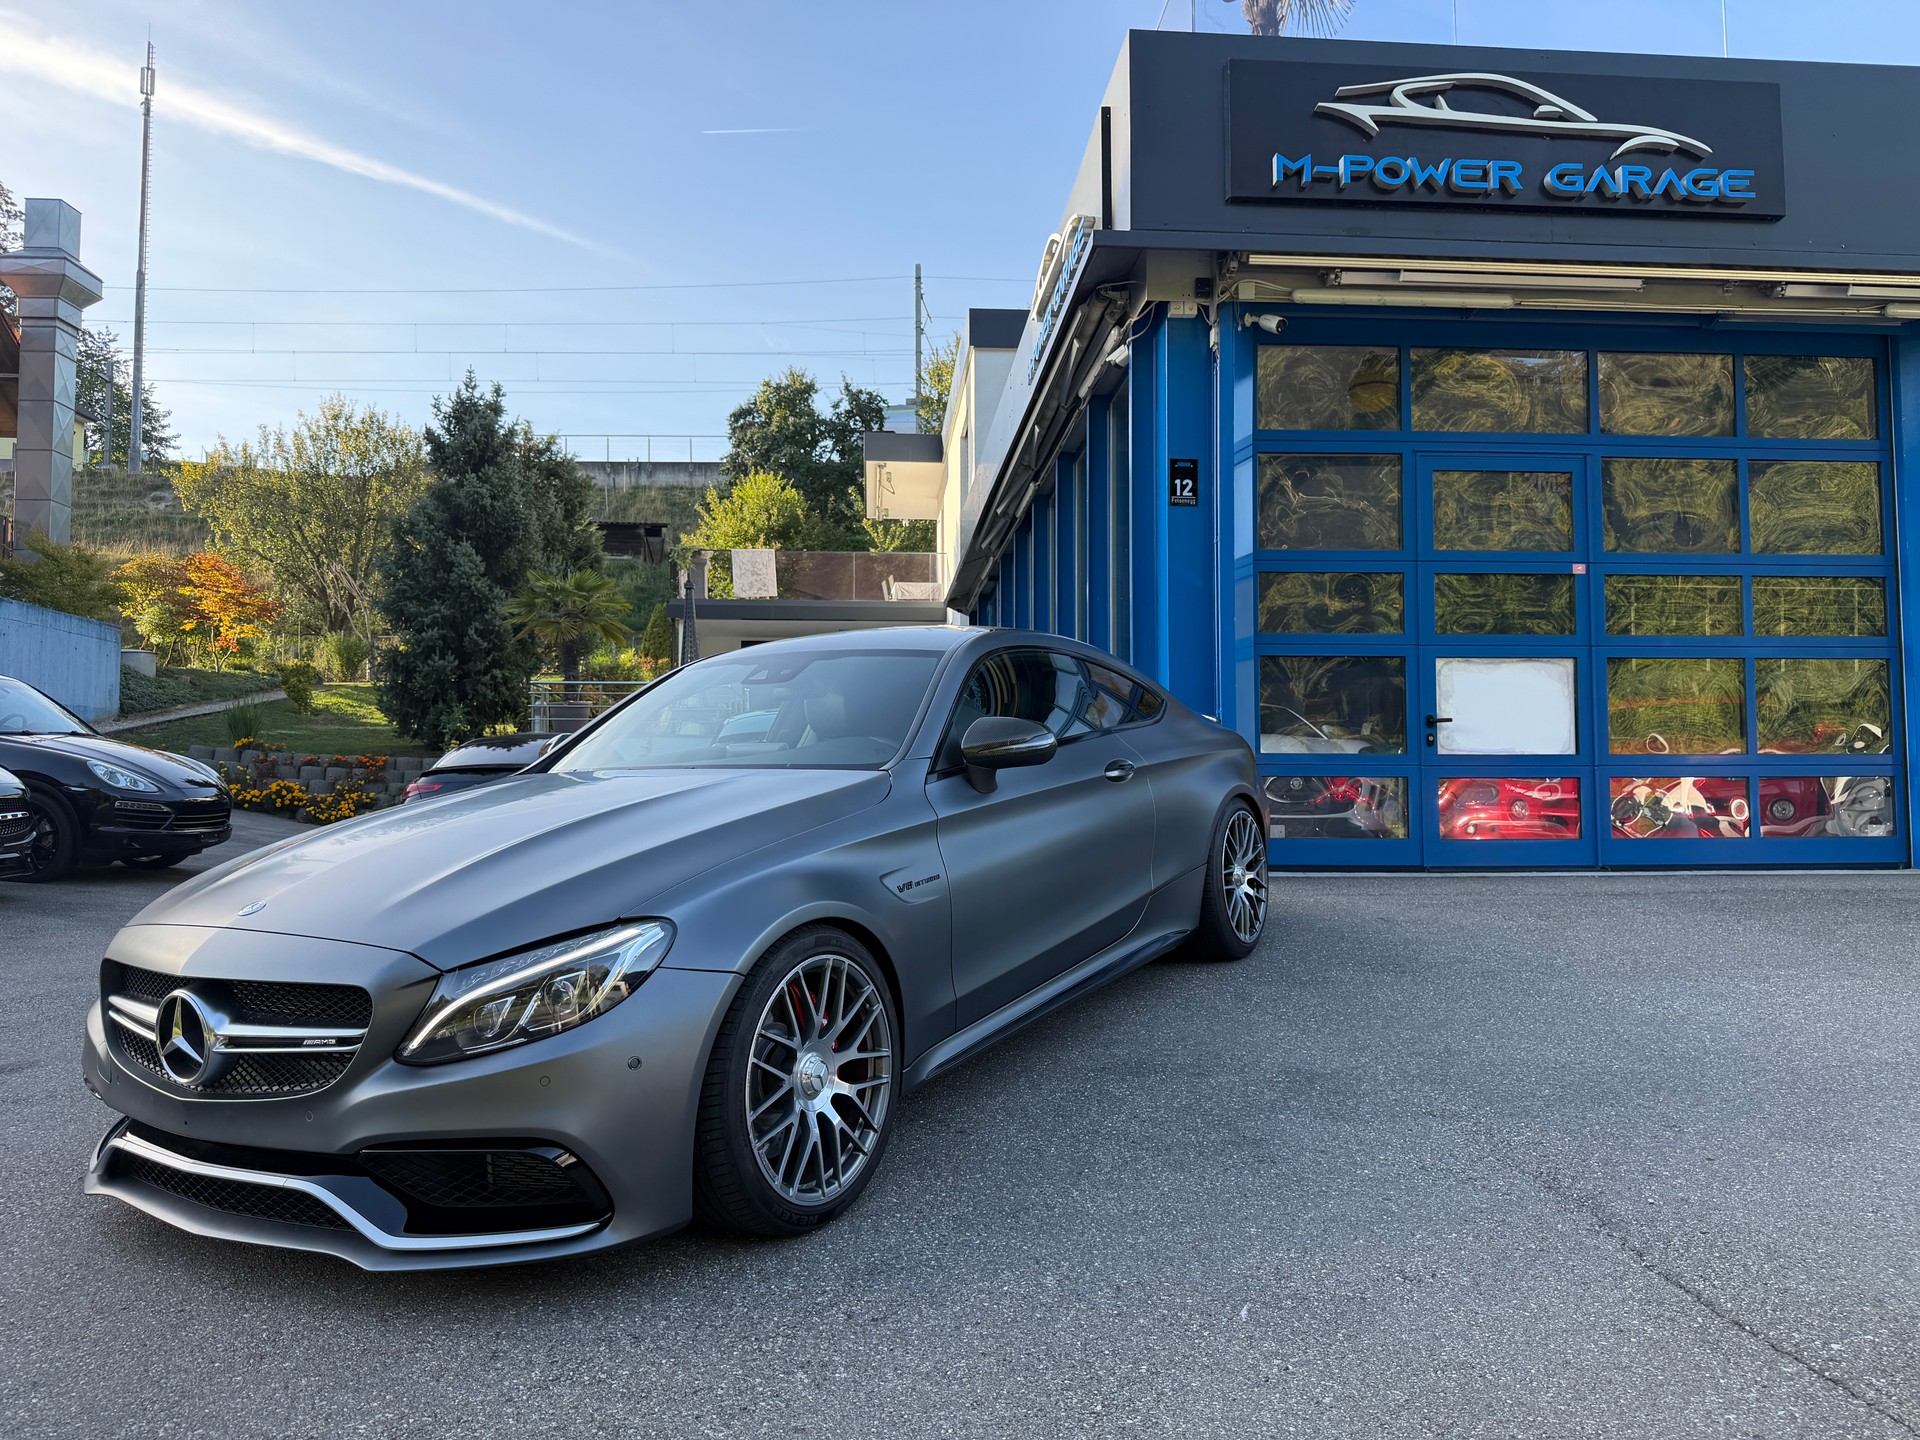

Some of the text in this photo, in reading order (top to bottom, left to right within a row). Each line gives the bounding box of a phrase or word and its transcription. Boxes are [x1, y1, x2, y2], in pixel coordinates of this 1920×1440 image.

[1273, 152, 1757, 200] M-POWER GARAGE
[1053, 215, 1086, 312] GARAGE
[1174, 478, 1193, 496] 12
[896, 880, 913, 894] V8
[770, 1202, 819, 1226] NEXEN
